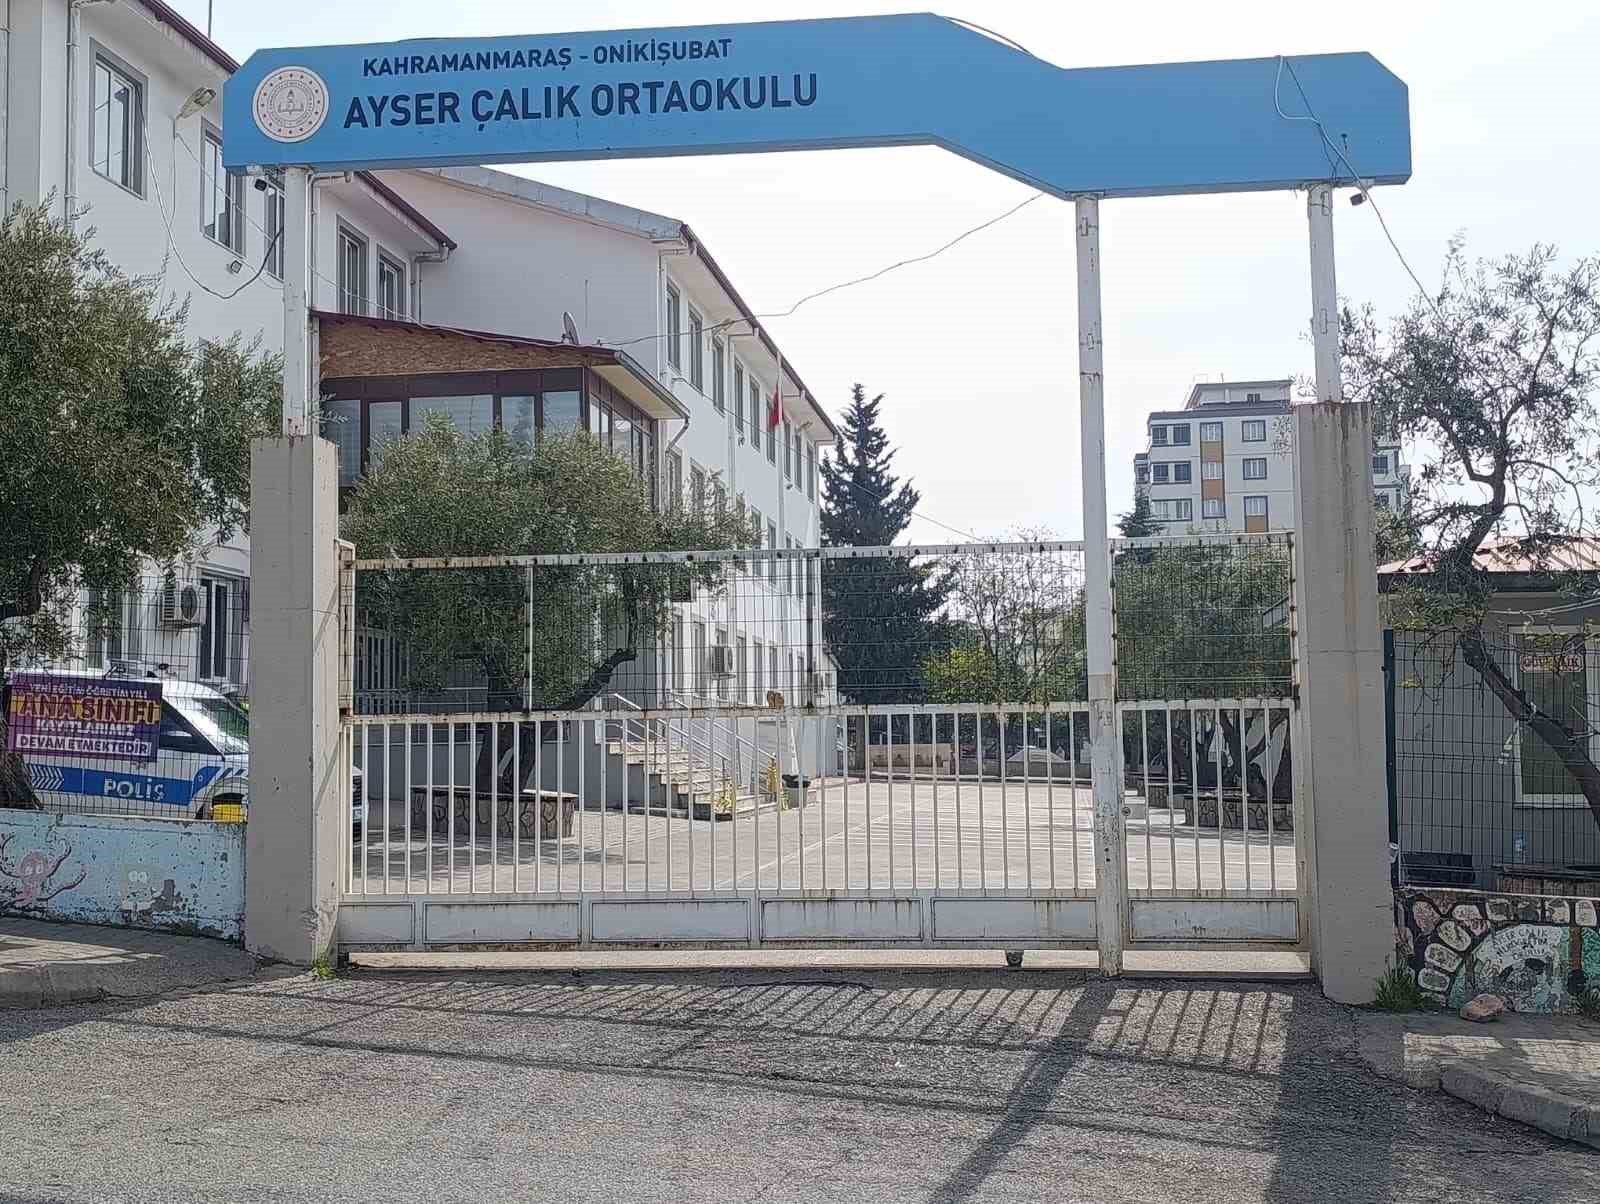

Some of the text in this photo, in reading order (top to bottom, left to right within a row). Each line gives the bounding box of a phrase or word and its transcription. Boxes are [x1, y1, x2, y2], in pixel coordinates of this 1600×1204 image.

[363, 48, 572, 77] KAHRAMANMARAŞ
[593, 38, 732, 66] ONİKİŞUBAT
[343, 92, 461, 129] AYSER
[471, 85, 581, 132] ÇALIK
[591, 73, 817, 117] ORTAOKULU
[17, 692, 156, 725] ANA SINIFI
[36, 719, 135, 737] KAYITLARIMIZ
[20, 735, 149, 754] DEVAM ETMEKTEDİR
[103, 777, 165, 800] POLİS
